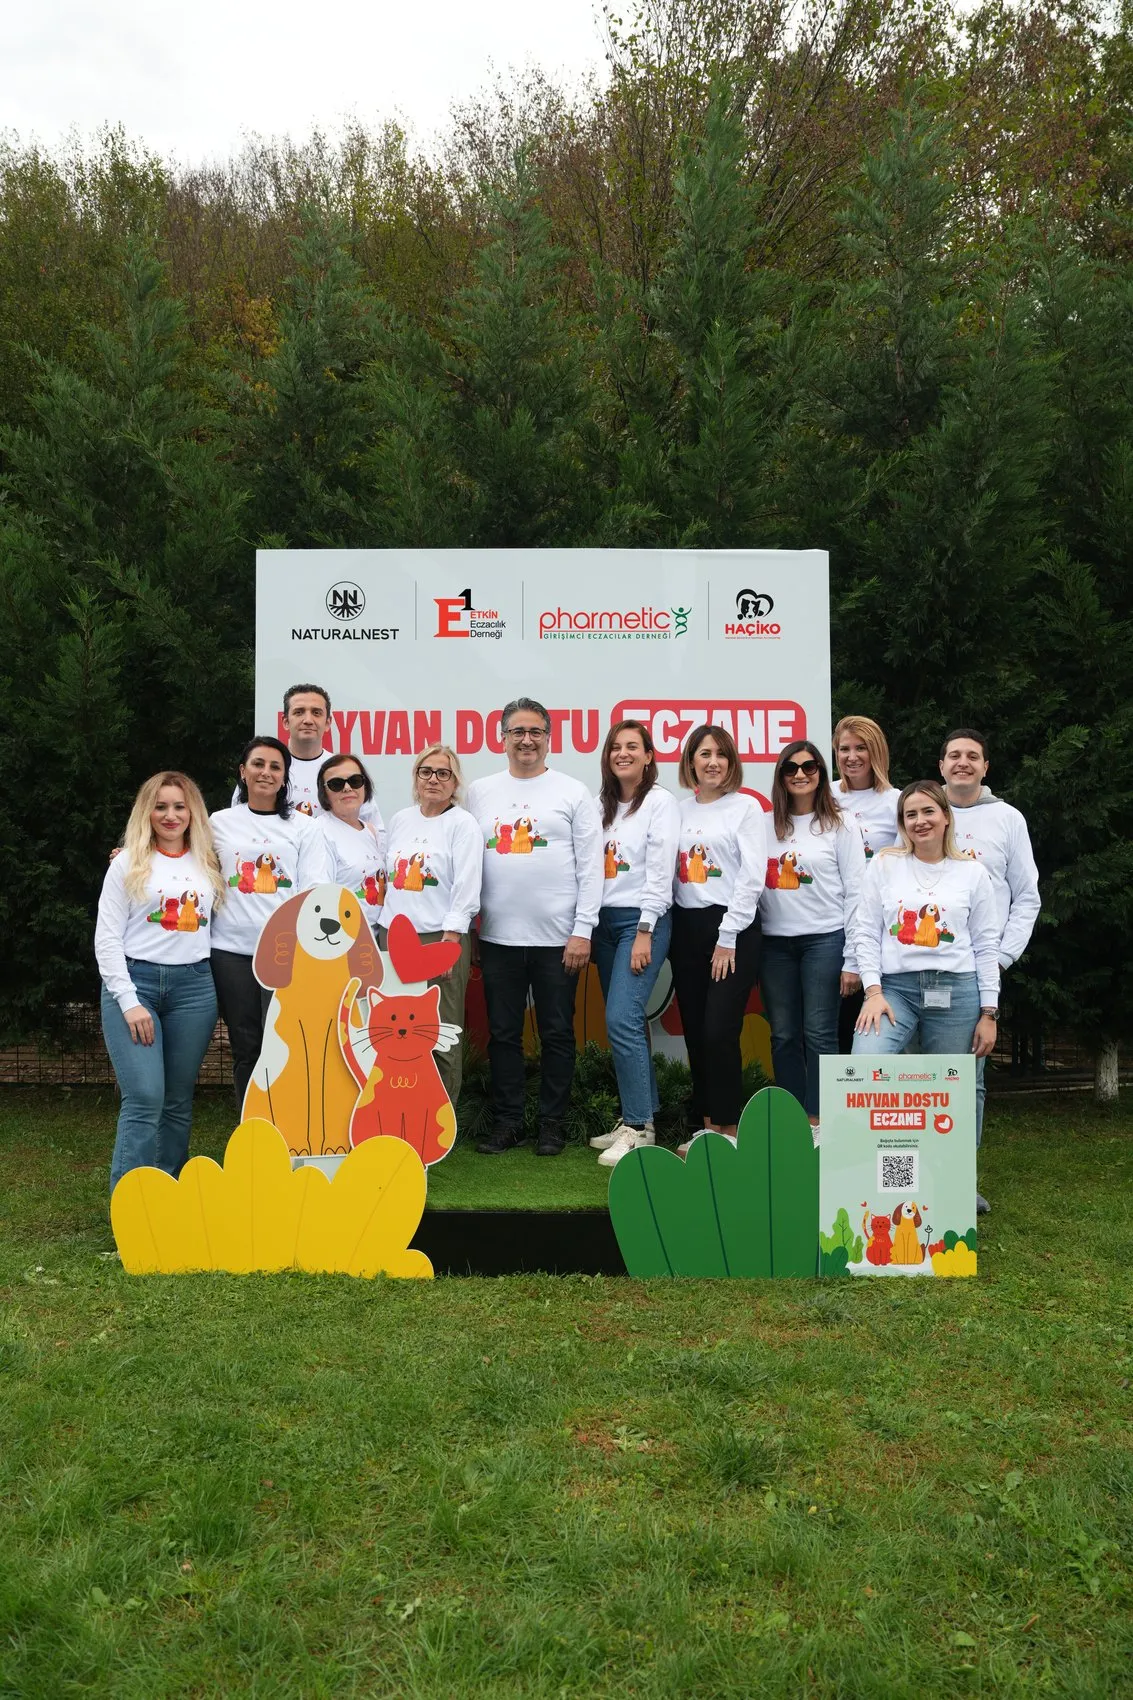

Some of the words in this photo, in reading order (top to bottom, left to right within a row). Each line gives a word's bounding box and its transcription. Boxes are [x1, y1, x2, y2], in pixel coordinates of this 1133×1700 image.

[470, 609, 498, 619] ETKİN
[470, 620, 506, 629] Eczacılık
[540, 607, 671, 639] pharmetic
[725, 620, 781, 636] HAÇİKO
[291, 628, 400, 640] NATURALNEST
[470, 630, 503, 639] Derneği
[278, 711, 442, 755] YVAN
[456, 709, 599, 754] DOTU
[847, 1093, 900, 1108] HAYVAN
[903, 1092, 950, 1107] DOSTU
[873, 1112, 922, 1126] ECZANE
